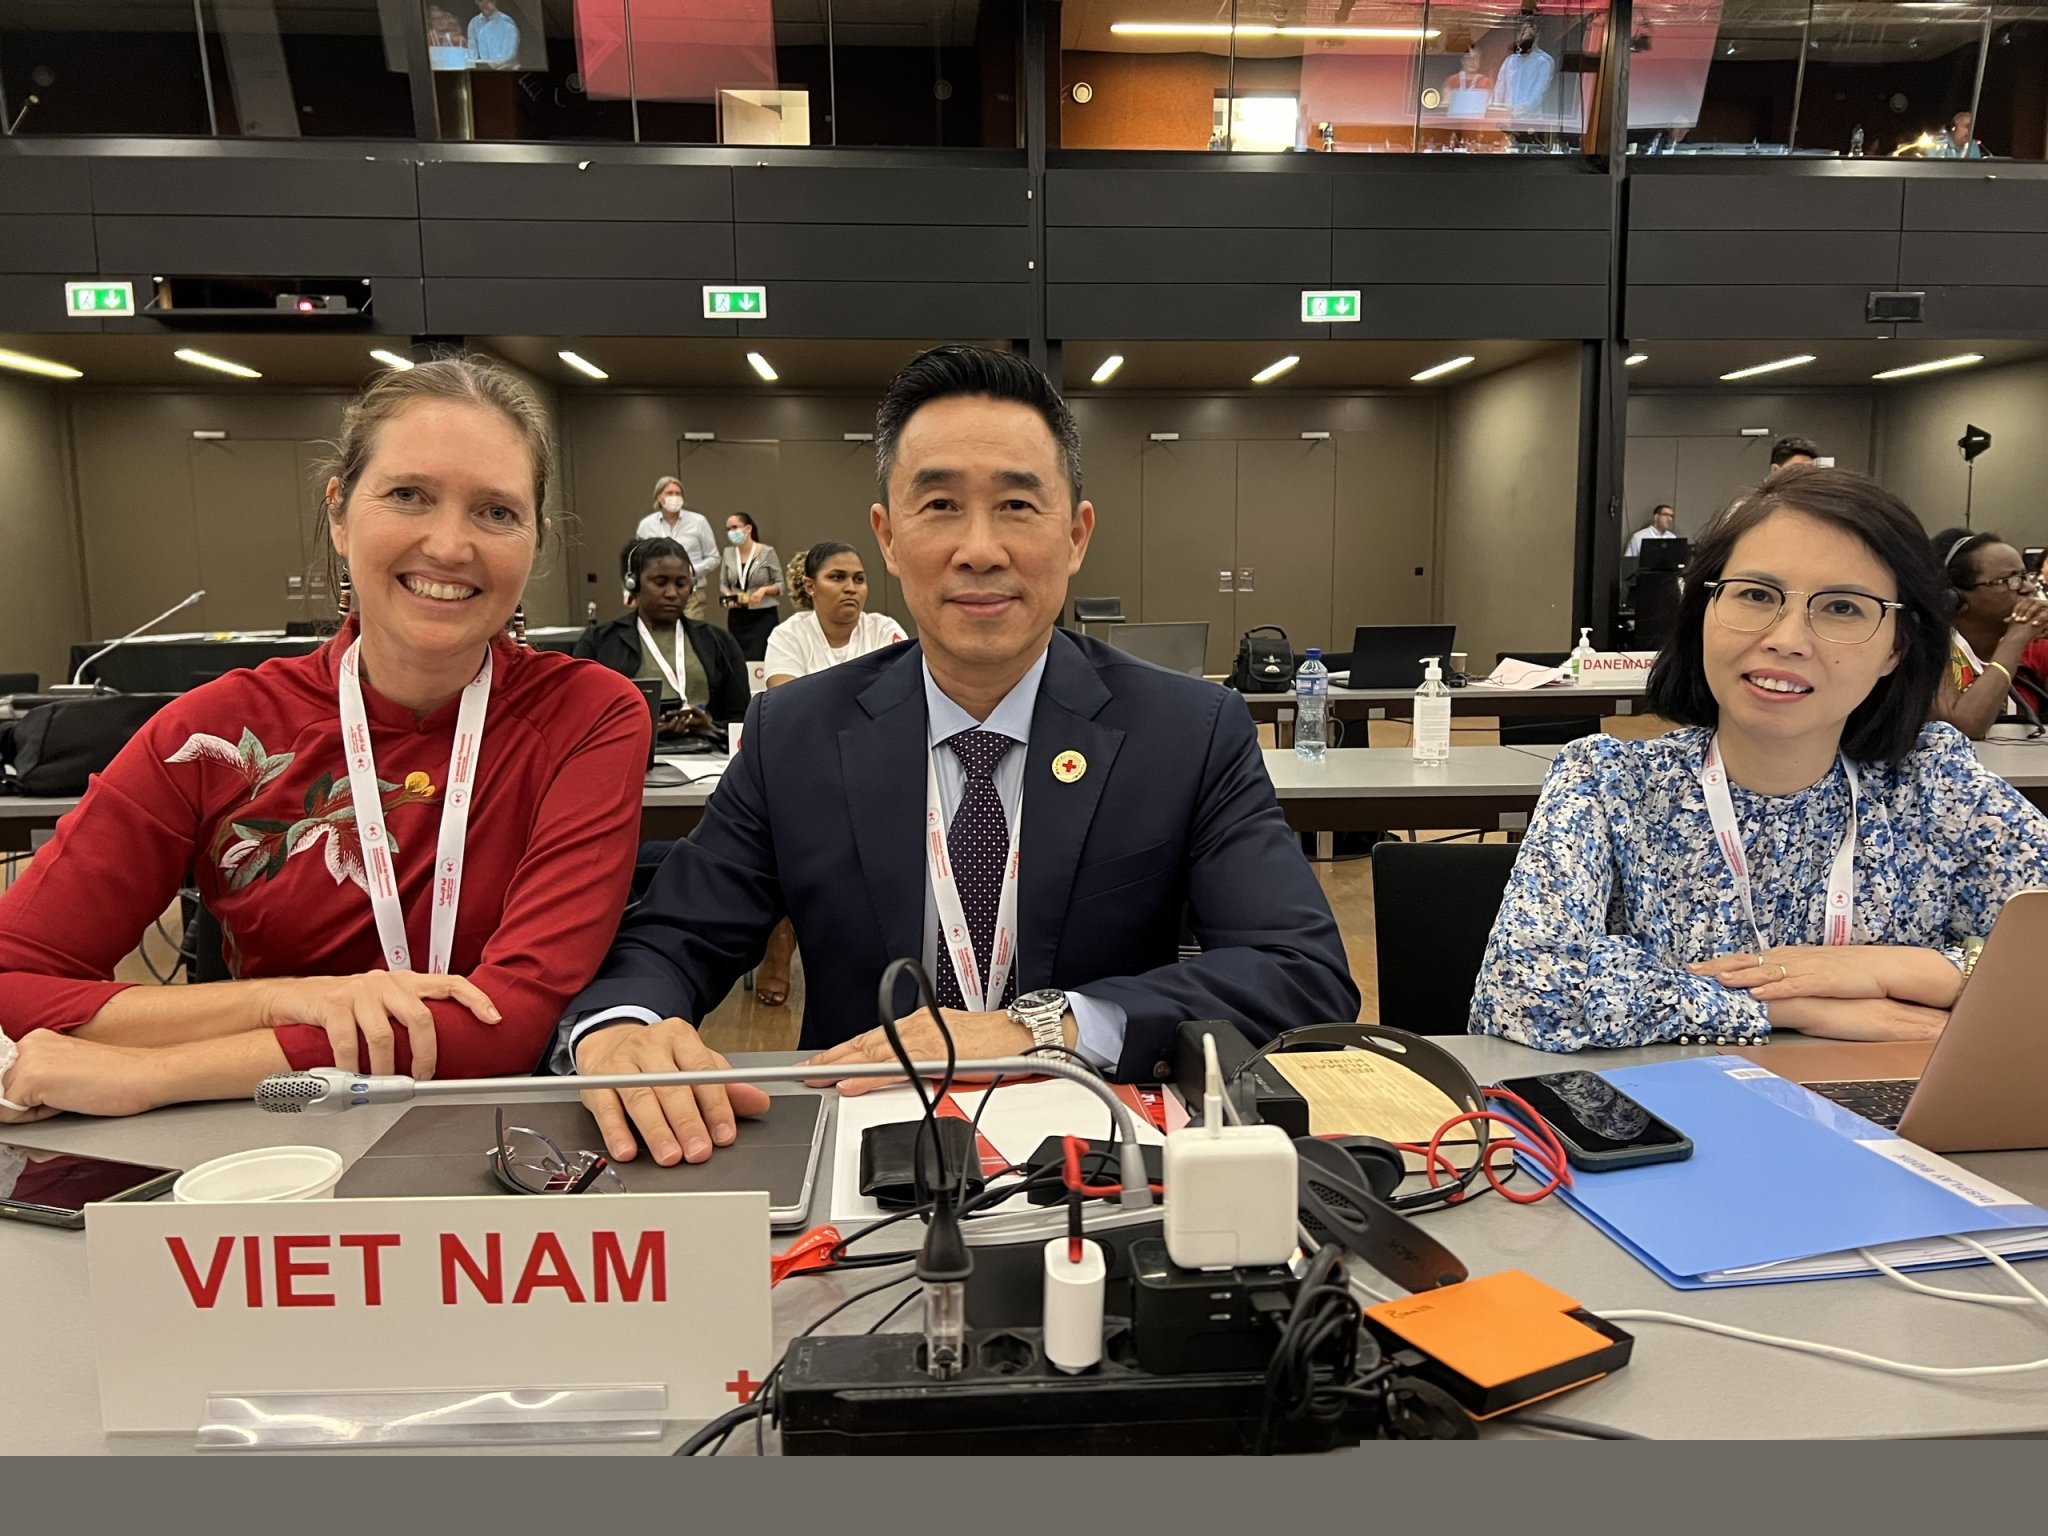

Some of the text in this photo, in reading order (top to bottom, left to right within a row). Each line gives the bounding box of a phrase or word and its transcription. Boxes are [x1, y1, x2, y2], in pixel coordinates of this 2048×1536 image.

[1583, 659, 1655, 670] DANEMAR
[1893, 1154, 1996, 1203] DISPLAY BOOK
[165, 1230, 667, 1308] VIET NAM
